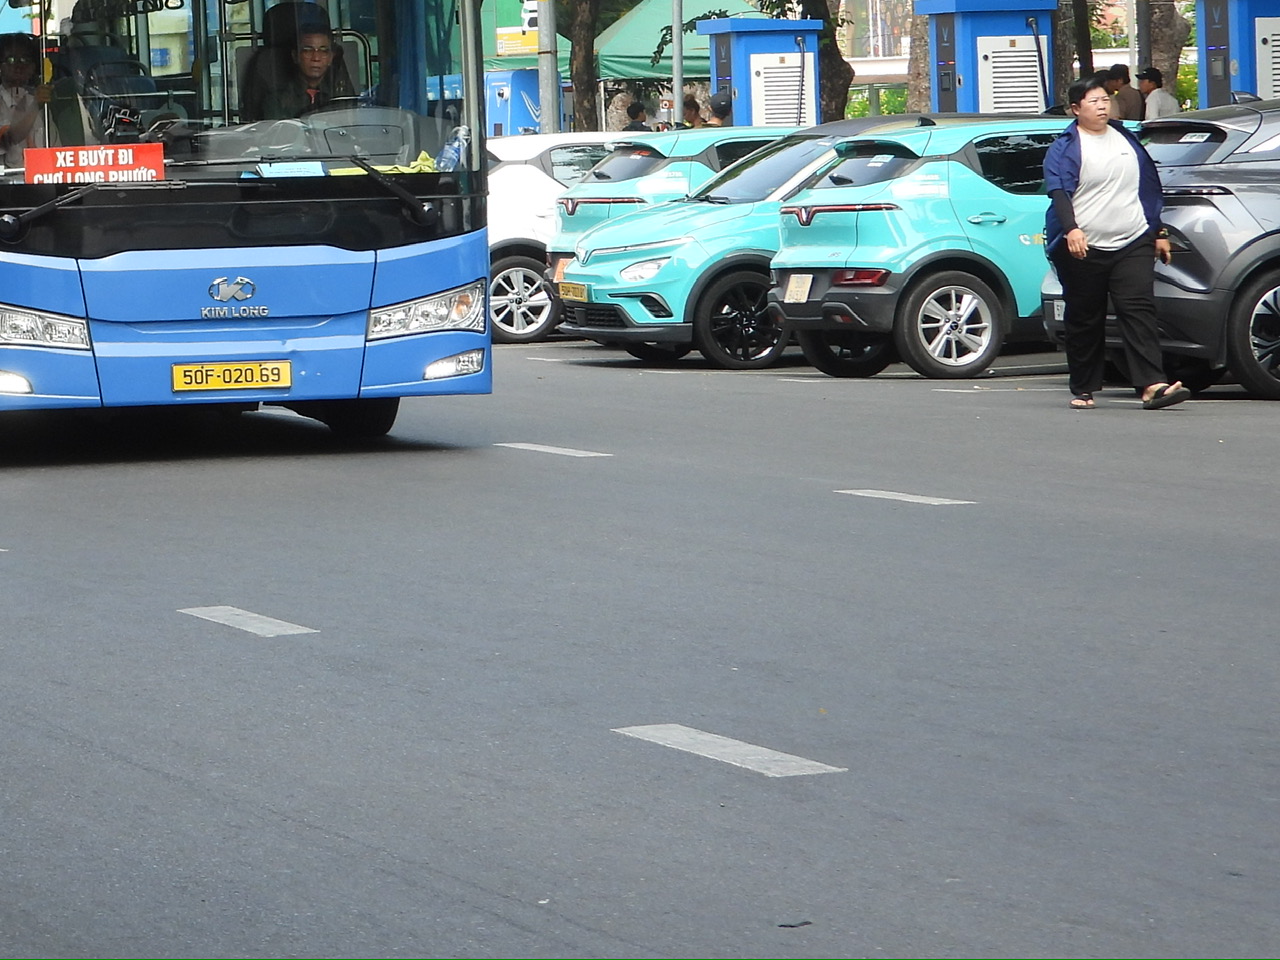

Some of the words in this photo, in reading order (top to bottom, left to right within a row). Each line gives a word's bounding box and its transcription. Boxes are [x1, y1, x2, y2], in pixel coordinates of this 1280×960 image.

[55, 150, 75, 168] XE
[78, 146, 115, 167] BUÝT
[118, 148, 133, 165] ĐI
[201, 306, 229, 319] KIM
[231, 305, 270, 318] LONG
[182, 366, 281, 386] 50F-020.69
